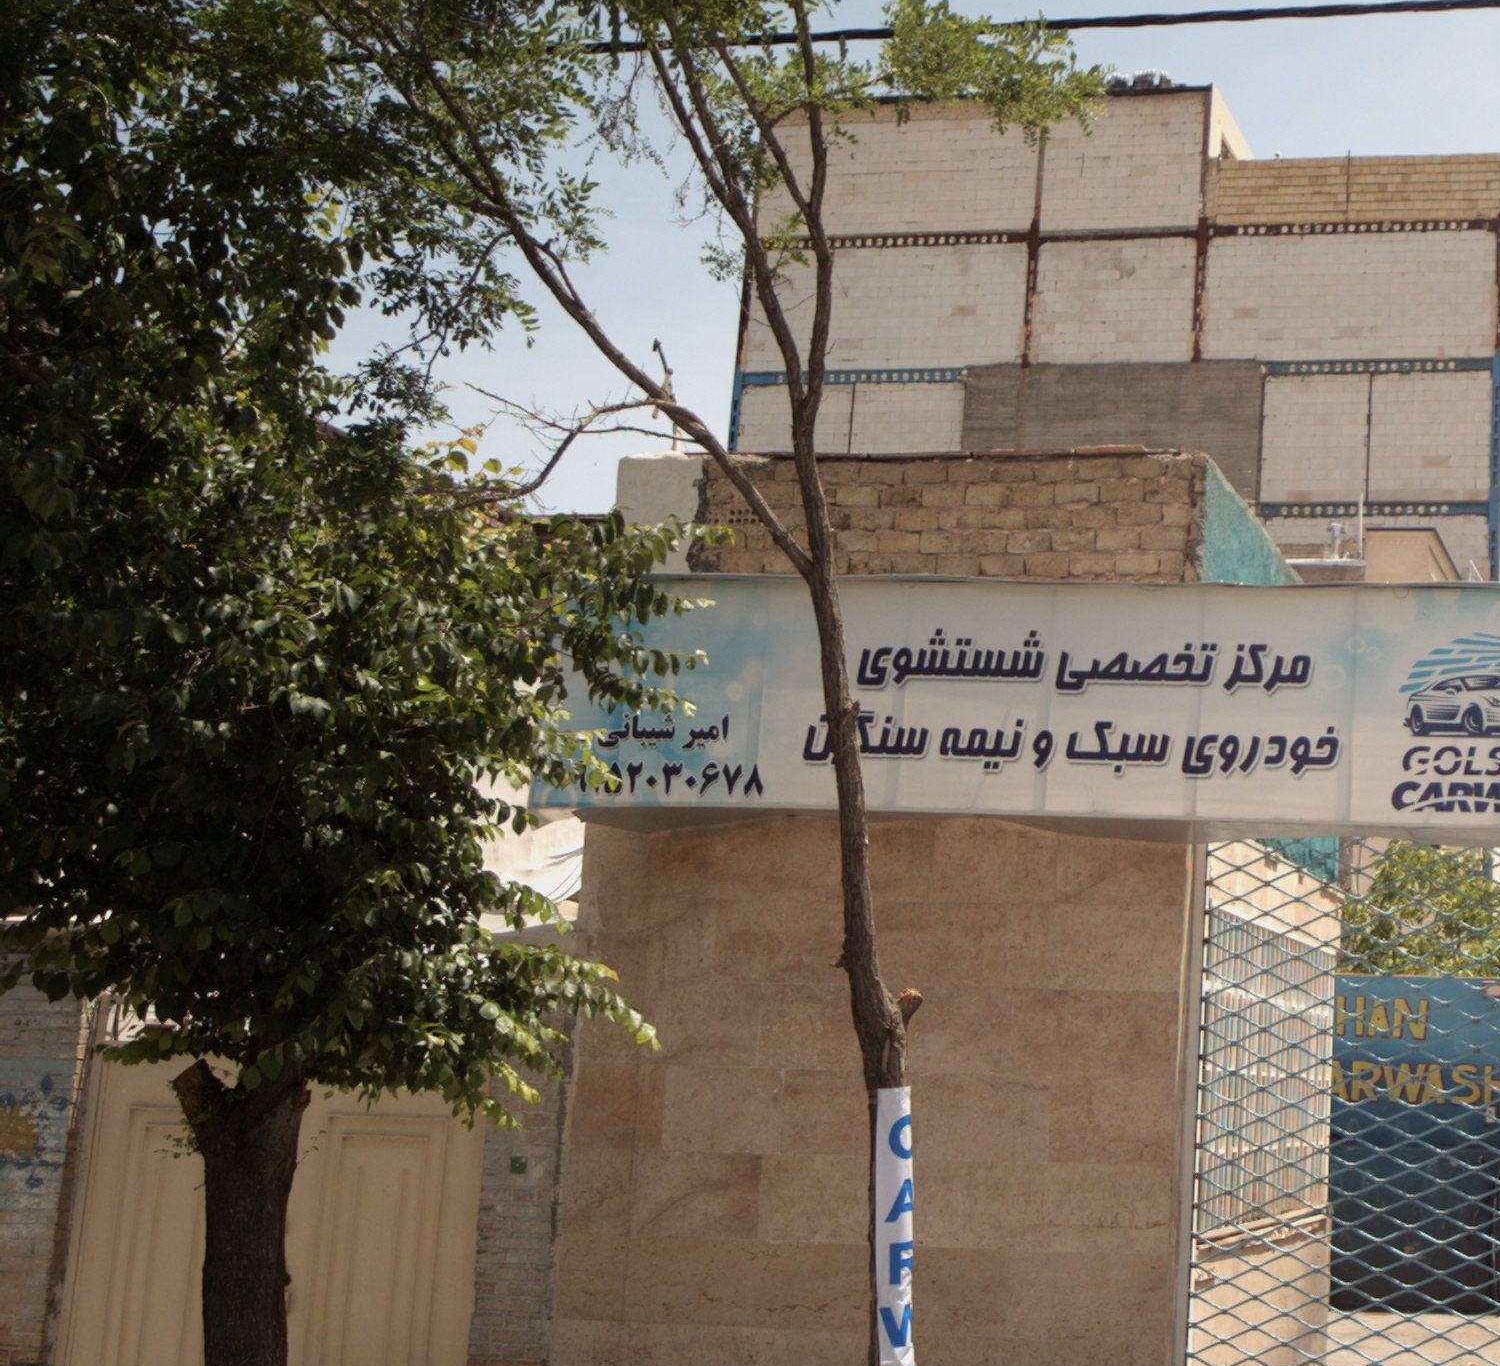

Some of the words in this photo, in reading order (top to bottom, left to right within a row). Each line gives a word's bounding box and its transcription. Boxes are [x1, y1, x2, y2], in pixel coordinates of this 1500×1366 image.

[856, 627, 1045, 686] شستشوی
[1055, 642, 1218, 691] تخصصی
[1222, 643, 1312, 692] مرکز
[597, 713, 676, 748] شیبانی
[681, 714, 730, 749] امیر
[802, 710, 929, 765] سنگن
[939, 718, 1025, 770] نیمه
[1031, 729, 1054, 769] و
[1065, 720, 1171, 774] سبک
[1181, 725, 1340, 775] خودروی
